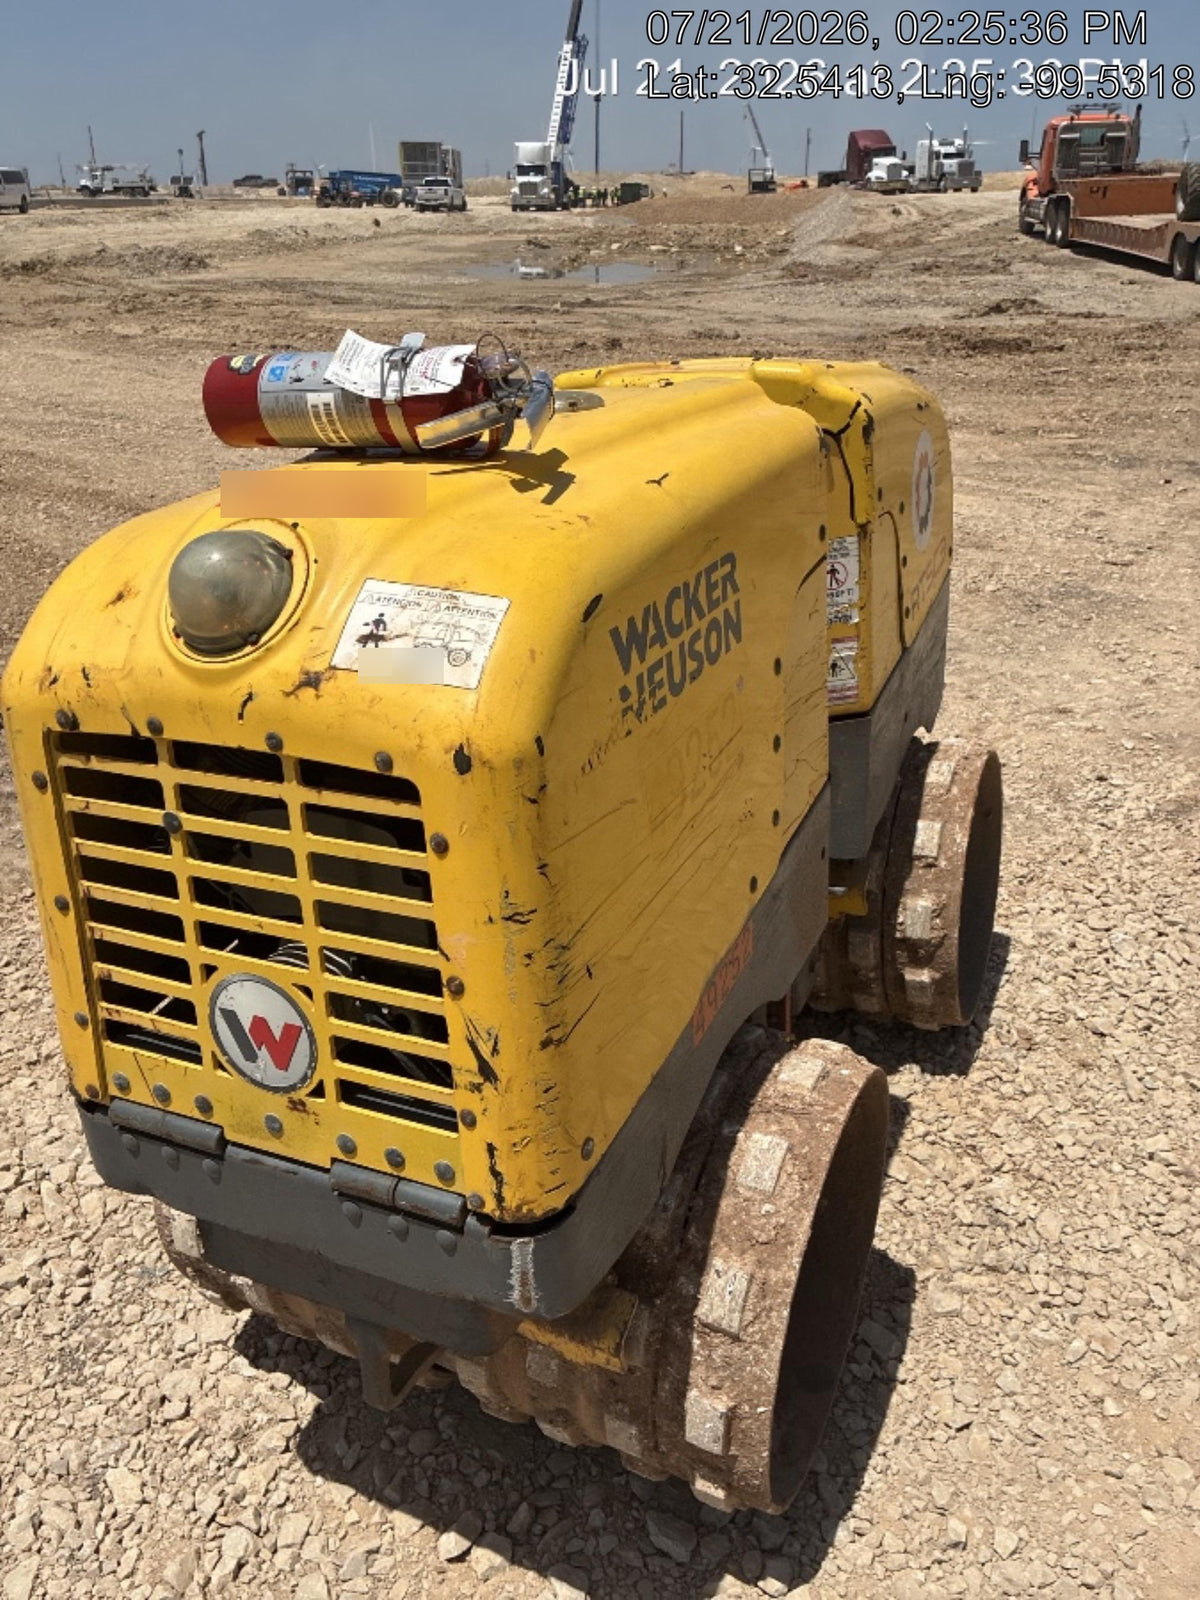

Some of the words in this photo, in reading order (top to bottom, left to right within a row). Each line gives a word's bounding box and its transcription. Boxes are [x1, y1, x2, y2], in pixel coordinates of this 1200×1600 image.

[416, 589, 462, 602] CAUTION
[608, 552, 740, 676] WACKER
[618, 599, 742, 737] NEUSON
